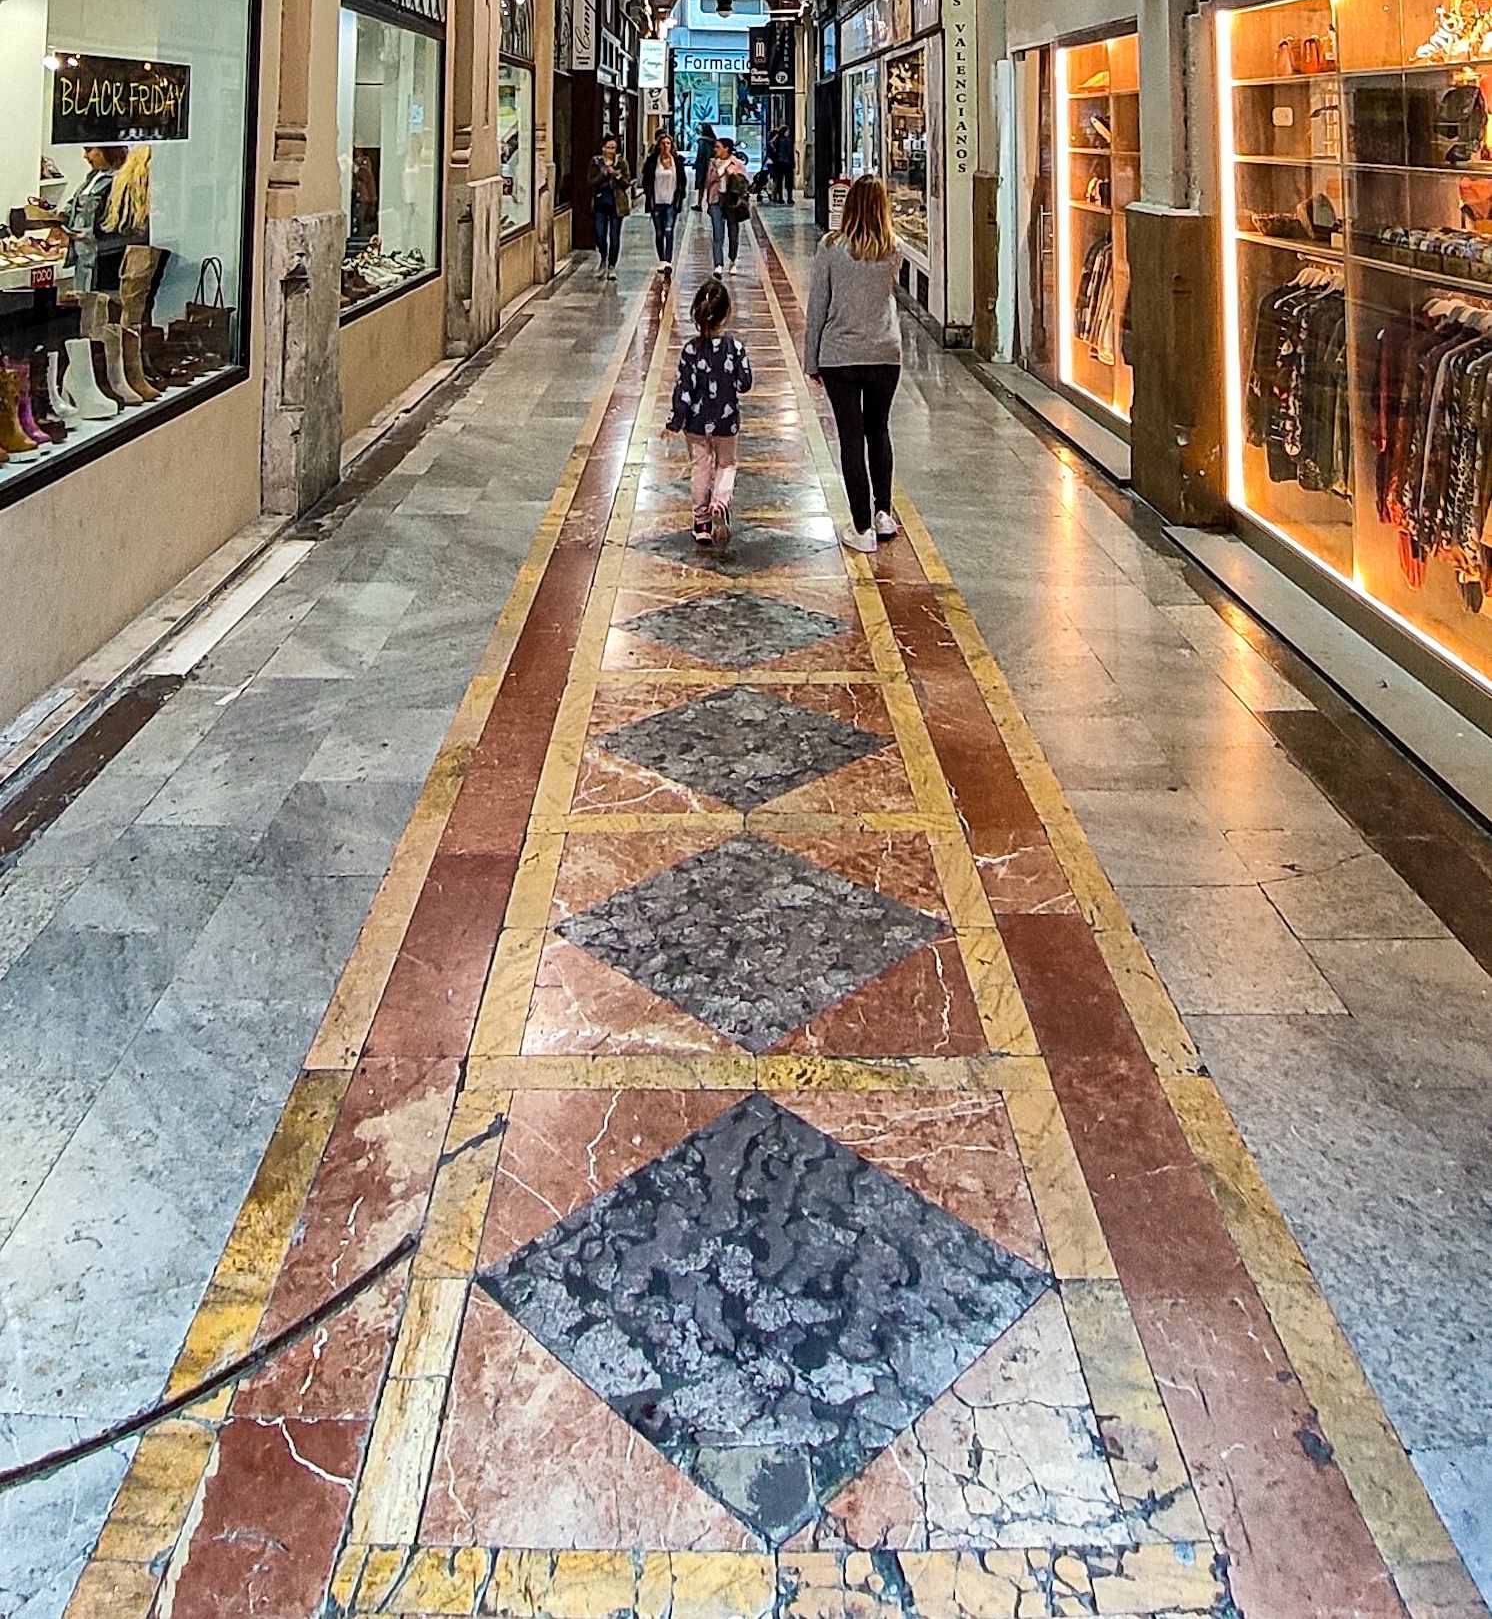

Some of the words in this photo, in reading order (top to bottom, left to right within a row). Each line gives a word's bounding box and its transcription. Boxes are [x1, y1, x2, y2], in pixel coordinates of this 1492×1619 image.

[60, 77, 126, 117] BLACK
[129, 83, 186, 131] FRIDAY
[954, 23, 968, 174] VALENCIANOS
